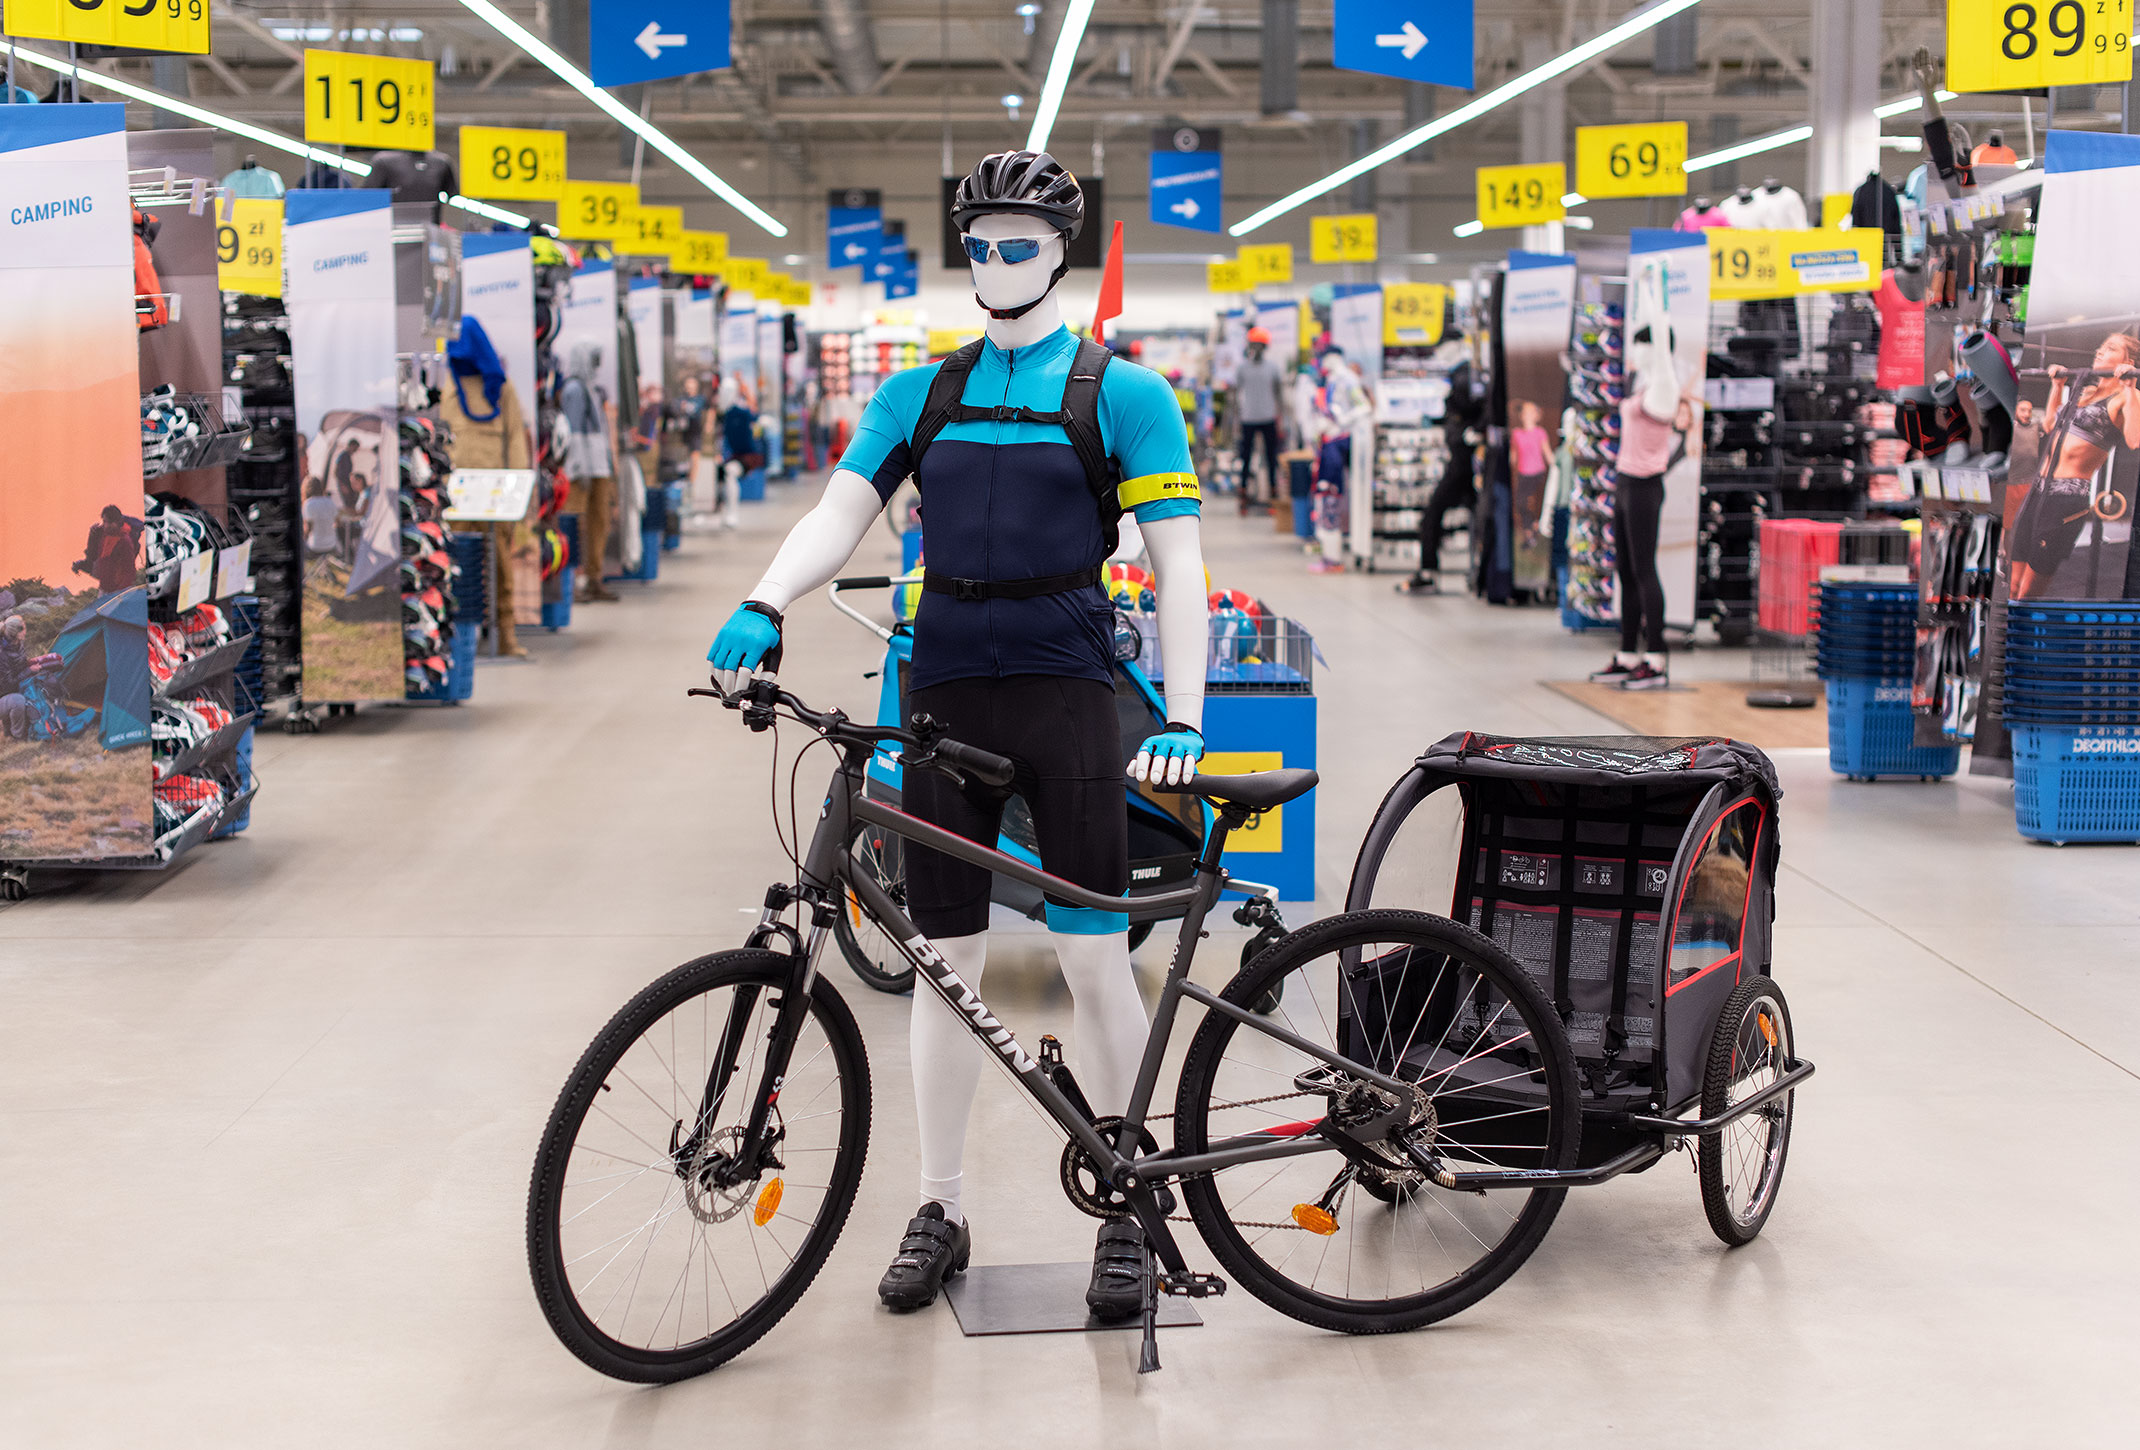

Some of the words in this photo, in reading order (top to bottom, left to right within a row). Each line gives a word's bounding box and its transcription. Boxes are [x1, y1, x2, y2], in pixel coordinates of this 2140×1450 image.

[2002, 0, 2085, 60] 89
[2094, 32, 2127, 53] 99
[316, 75, 400, 124] 119
[492, 146, 538, 182] 89
[1610, 141, 1659, 179] 69
[1486, 178, 1544, 211] 149
[11, 195, 93, 225] CAMPING
[580, 195, 619, 224] 39
[247, 246, 273, 266] 99
[312, 250, 369, 273] CAMPING
[1711, 248, 1750, 279] 19
[2072, 738, 2140, 754] DECATHLO
[877, 755, 896, 772] THULE
[1132, 866, 1162, 880] THULE
